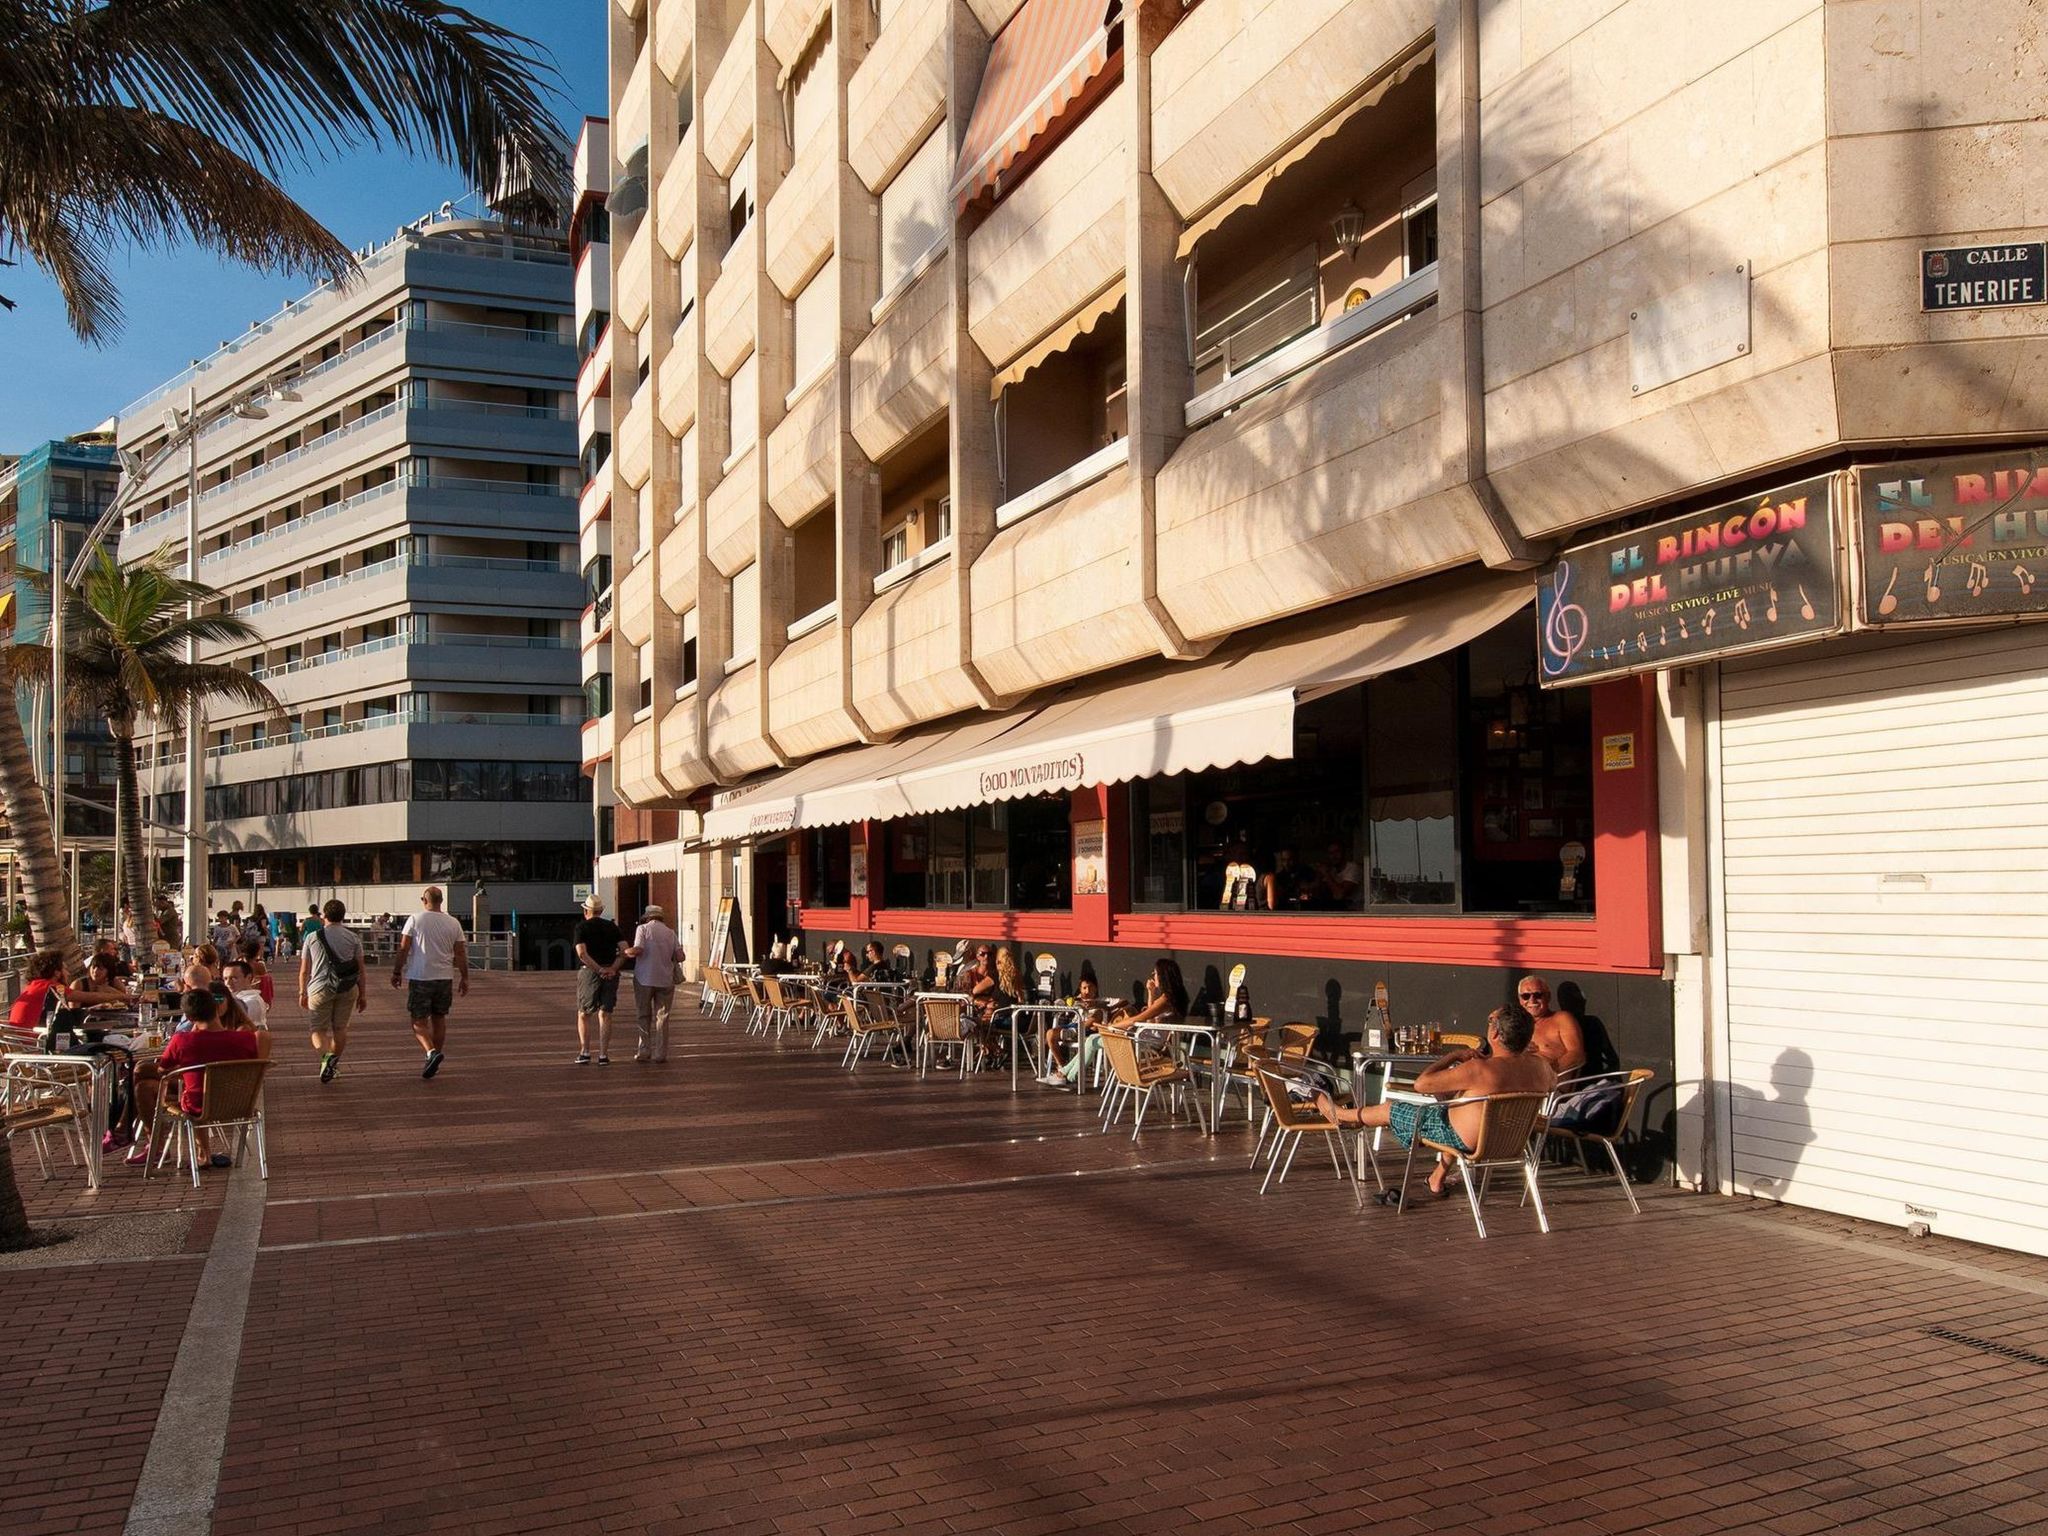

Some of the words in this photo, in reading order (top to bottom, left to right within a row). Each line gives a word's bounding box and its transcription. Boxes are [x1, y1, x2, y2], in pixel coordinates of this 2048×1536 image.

[1967, 248, 2028, 265] CALLE
[1935, 278, 2033, 305] TENERIFE
[1877, 478, 1932, 511] EL
[1610, 545, 1644, 576] EL
[1657, 496, 1808, 566] RINCÓN
[1880, 516, 1974, 554] DEL
[1988, 551, 2007, 561] EN
[2011, 547, 2047, 559] VIVO
[1609, 574, 1669, 614] DEL
[1670, 601, 1684, 613] EN
[1684, 596, 1710, 609] VIVO
[1716, 589, 1741, 602] LIVE
